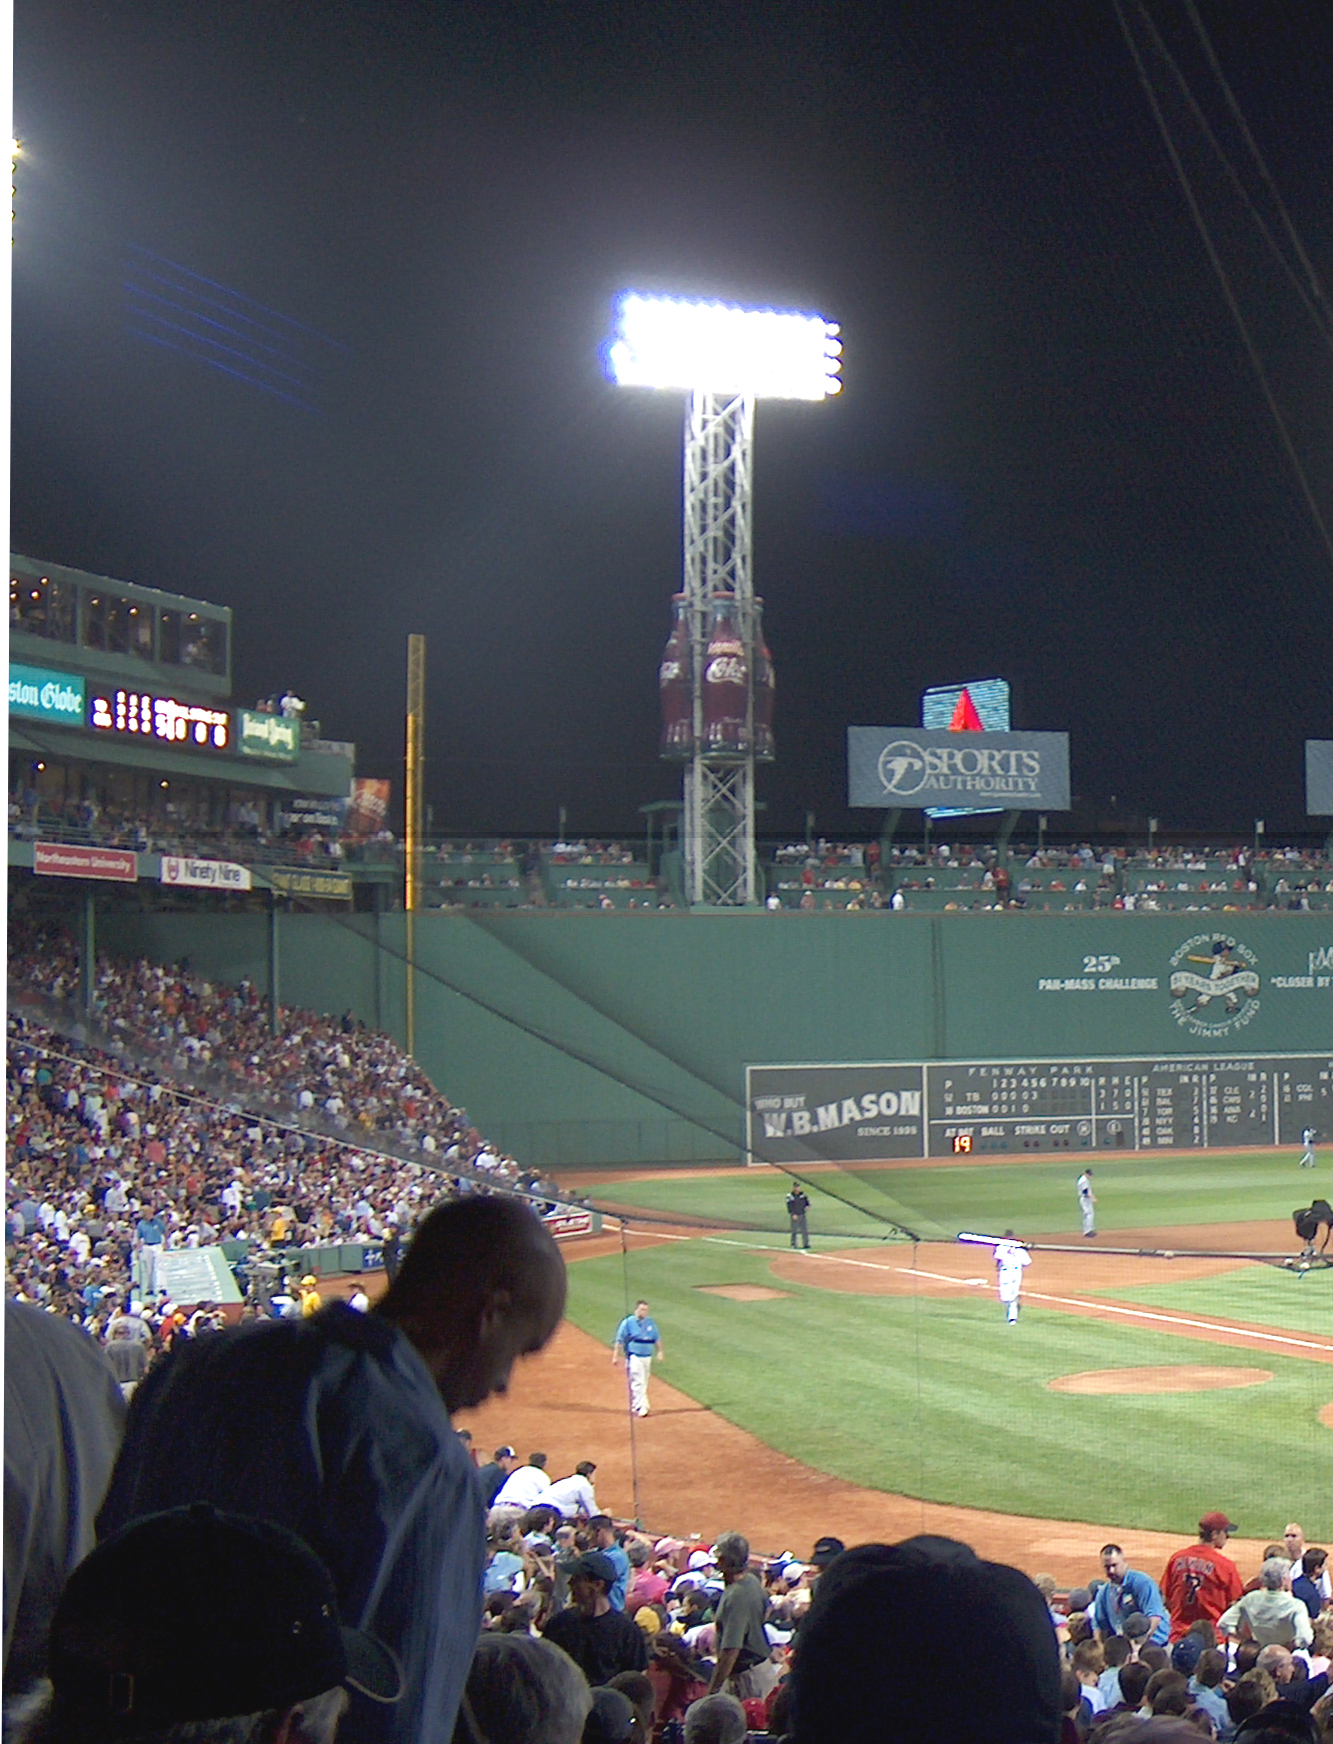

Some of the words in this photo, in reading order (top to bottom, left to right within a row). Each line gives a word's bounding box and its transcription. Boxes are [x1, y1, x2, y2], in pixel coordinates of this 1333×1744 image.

[924, 747, 1040, 776] SPORTS
[924, 775, 1038, 791] AUTHORITY
[184, 861, 216, 883] Ninety
[219, 864, 241, 882] Nine
[1169, 933, 1211, 967] BOSTON
[1212, 933, 1236, 947] RED
[1237, 943, 1259, 966] SOX
[1189, 1026, 1230, 1038] JIMMY
[1234, 1000, 1261, 1031] FUND
[967, 1067, 1038, 1077] FENWAY
[1050, 1065, 1094, 1075] PARK
[1152, 1063, 1209, 1073] AMERICAN
[1213, 1062, 1255, 1071] LEAGUE
[856, 1126, 891, 1137] SINCE
[981, 1126, 1005, 1137] BALL
[1014, 1125, 1046, 1136] STRIKE
[1049, 1124, 1070, 1134] OUT
[954, 1135, 972, 1153] 19
